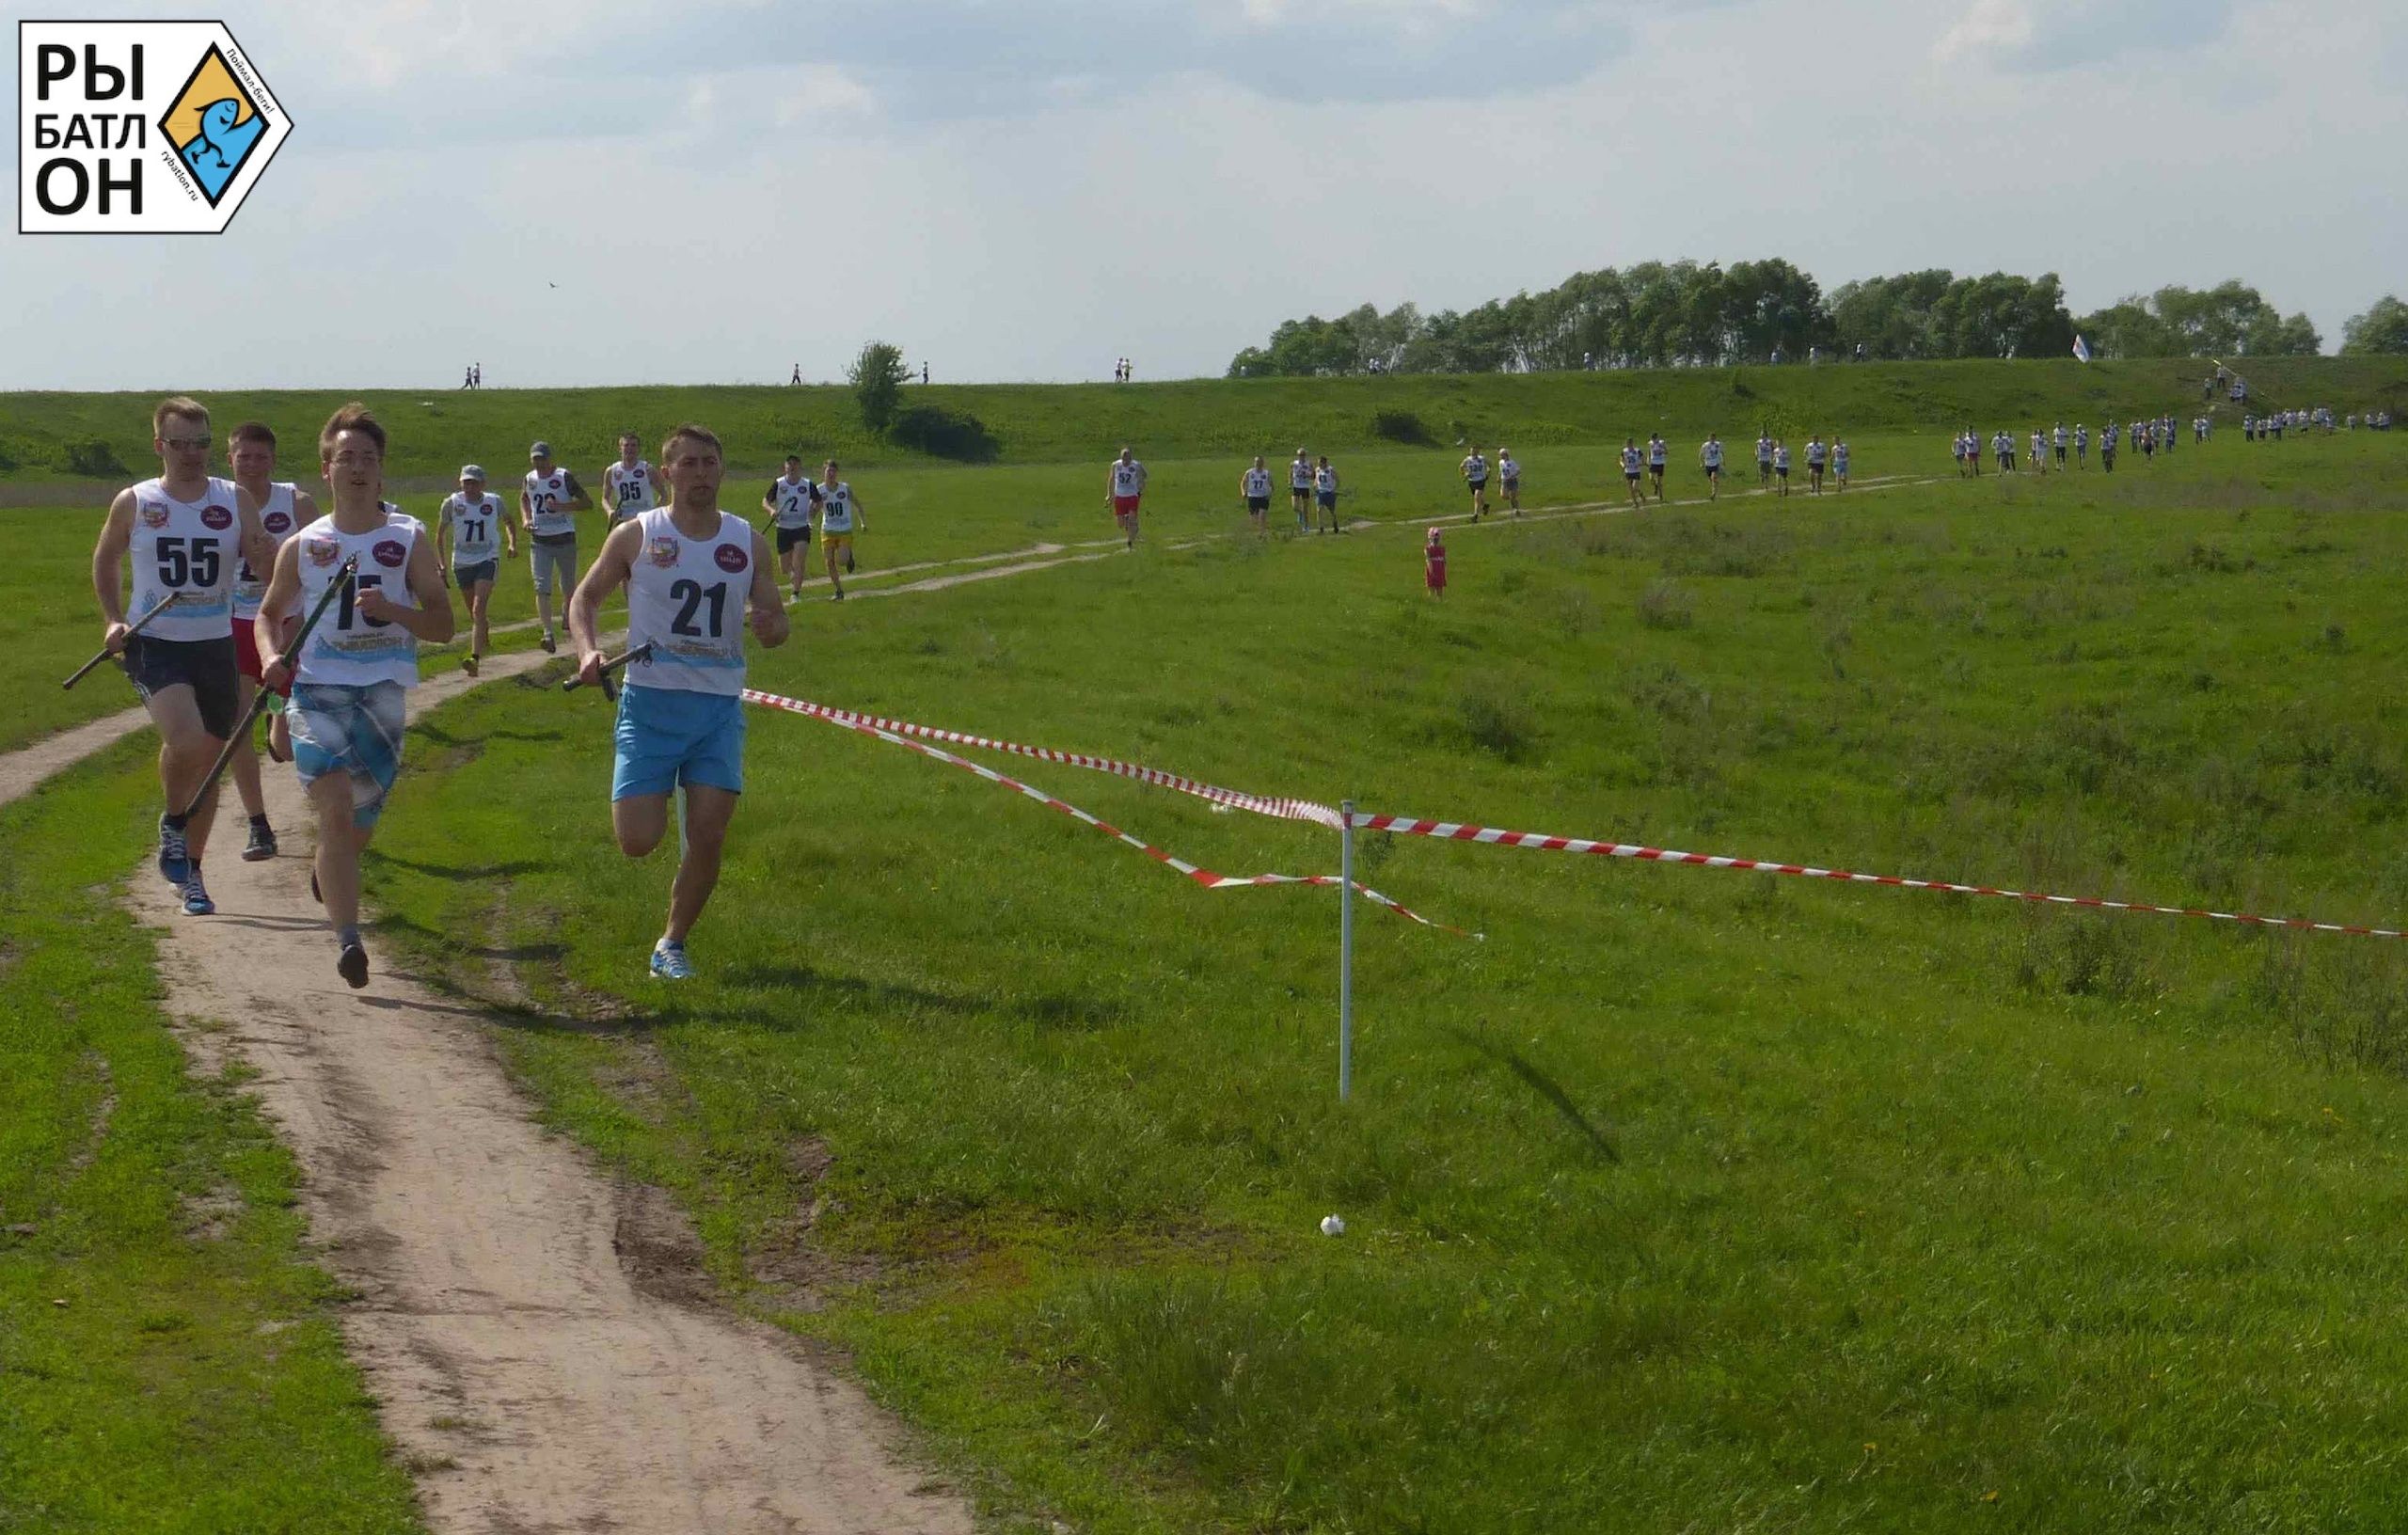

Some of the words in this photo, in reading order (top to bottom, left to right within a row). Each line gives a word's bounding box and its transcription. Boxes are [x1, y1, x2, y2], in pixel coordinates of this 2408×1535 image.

[464, 519, 484, 543] 71
[156, 536, 220, 588] 55
[669, 578, 728, 639] 21
